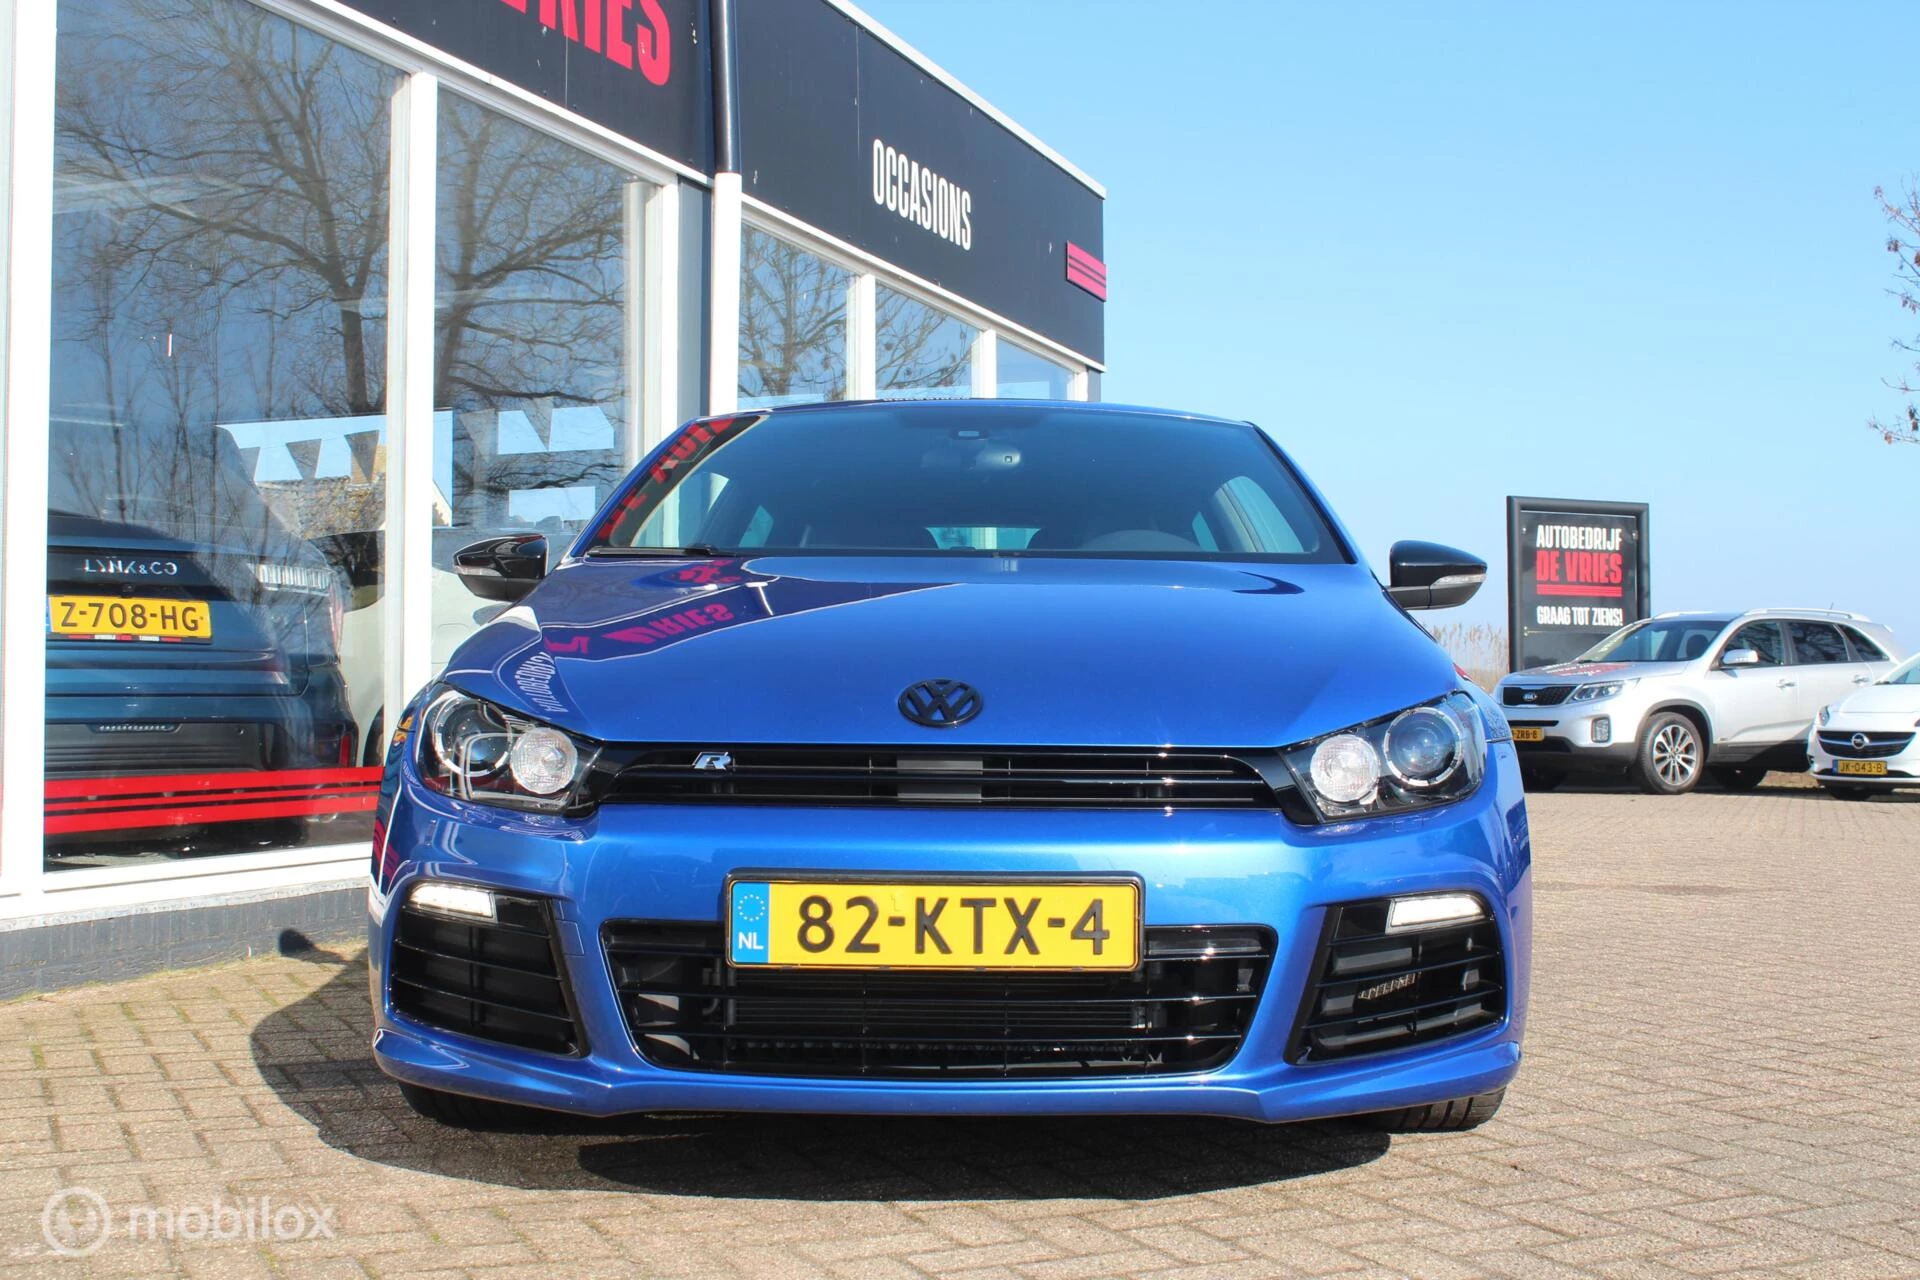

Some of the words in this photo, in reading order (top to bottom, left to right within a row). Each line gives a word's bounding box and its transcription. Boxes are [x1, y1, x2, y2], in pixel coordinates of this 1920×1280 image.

[872, 138, 971, 251] OCCASIONS
[1536, 525, 1622, 550] AUTOBEDRIJF
[1536, 550, 1560, 582] DE
[1564, 551, 1623, 584] VRIES
[60, 601, 199, 632] Z-708-HG
[1536, 605, 1571, 625] GRAAG
[1572, 606, 1590, 626] TOT
[1591, 607, 1623, 627] ZIENS!
[692, 751, 731, 770] R
[797, 895, 1110, 955] 82-KTX-4
[738, 931, 764, 951] NL
